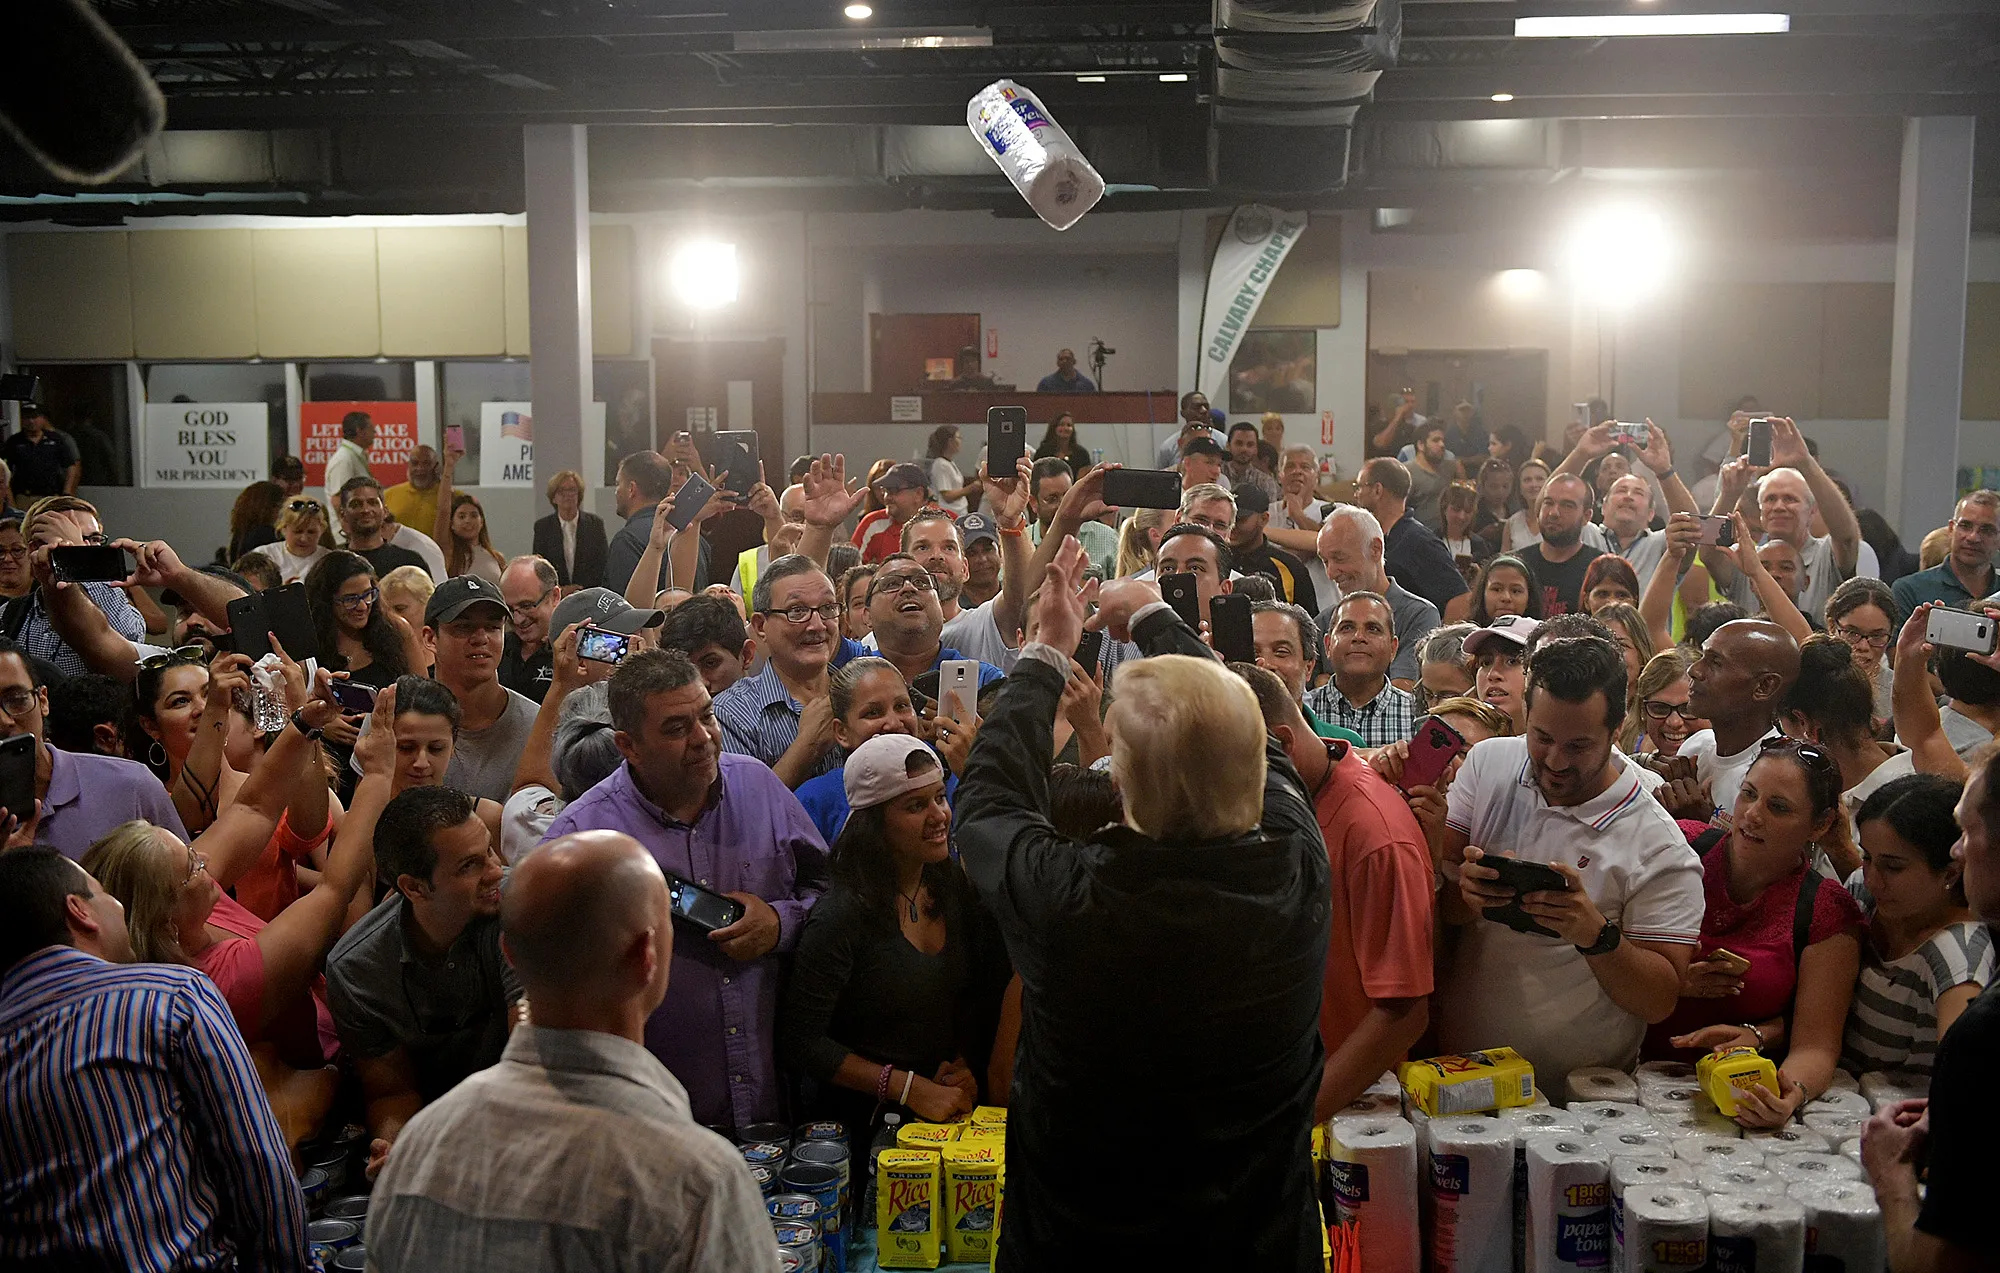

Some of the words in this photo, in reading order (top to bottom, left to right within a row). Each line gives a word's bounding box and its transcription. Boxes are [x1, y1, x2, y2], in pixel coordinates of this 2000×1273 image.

[1208, 282, 1258, 363] CALVARY
[1249, 218, 1302, 285] CHAPEL
[184, 411, 229, 426] GOD
[178, 431, 236, 445] BLESS
[312, 424, 342, 437] LET
[374, 424, 408, 437] AKE
[306, 438, 341, 451] PUE
[373, 438, 414, 450] RICO
[521, 444, 532, 460] P
[187, 450, 227, 465] YOU
[369, 451, 410, 464] GAIN
[183, 470, 256, 480] PRESIDENT
[502, 464, 532, 480] AME
[888, 1180, 929, 1216] Rico
[954, 1181, 996, 1216] Rico
[1566, 1186, 1577, 1206] 1
[1563, 1222, 1608, 1239] pape
[1574, 1237, 1604, 1252] tow
[1654, 1242, 1666, 1263] 1
